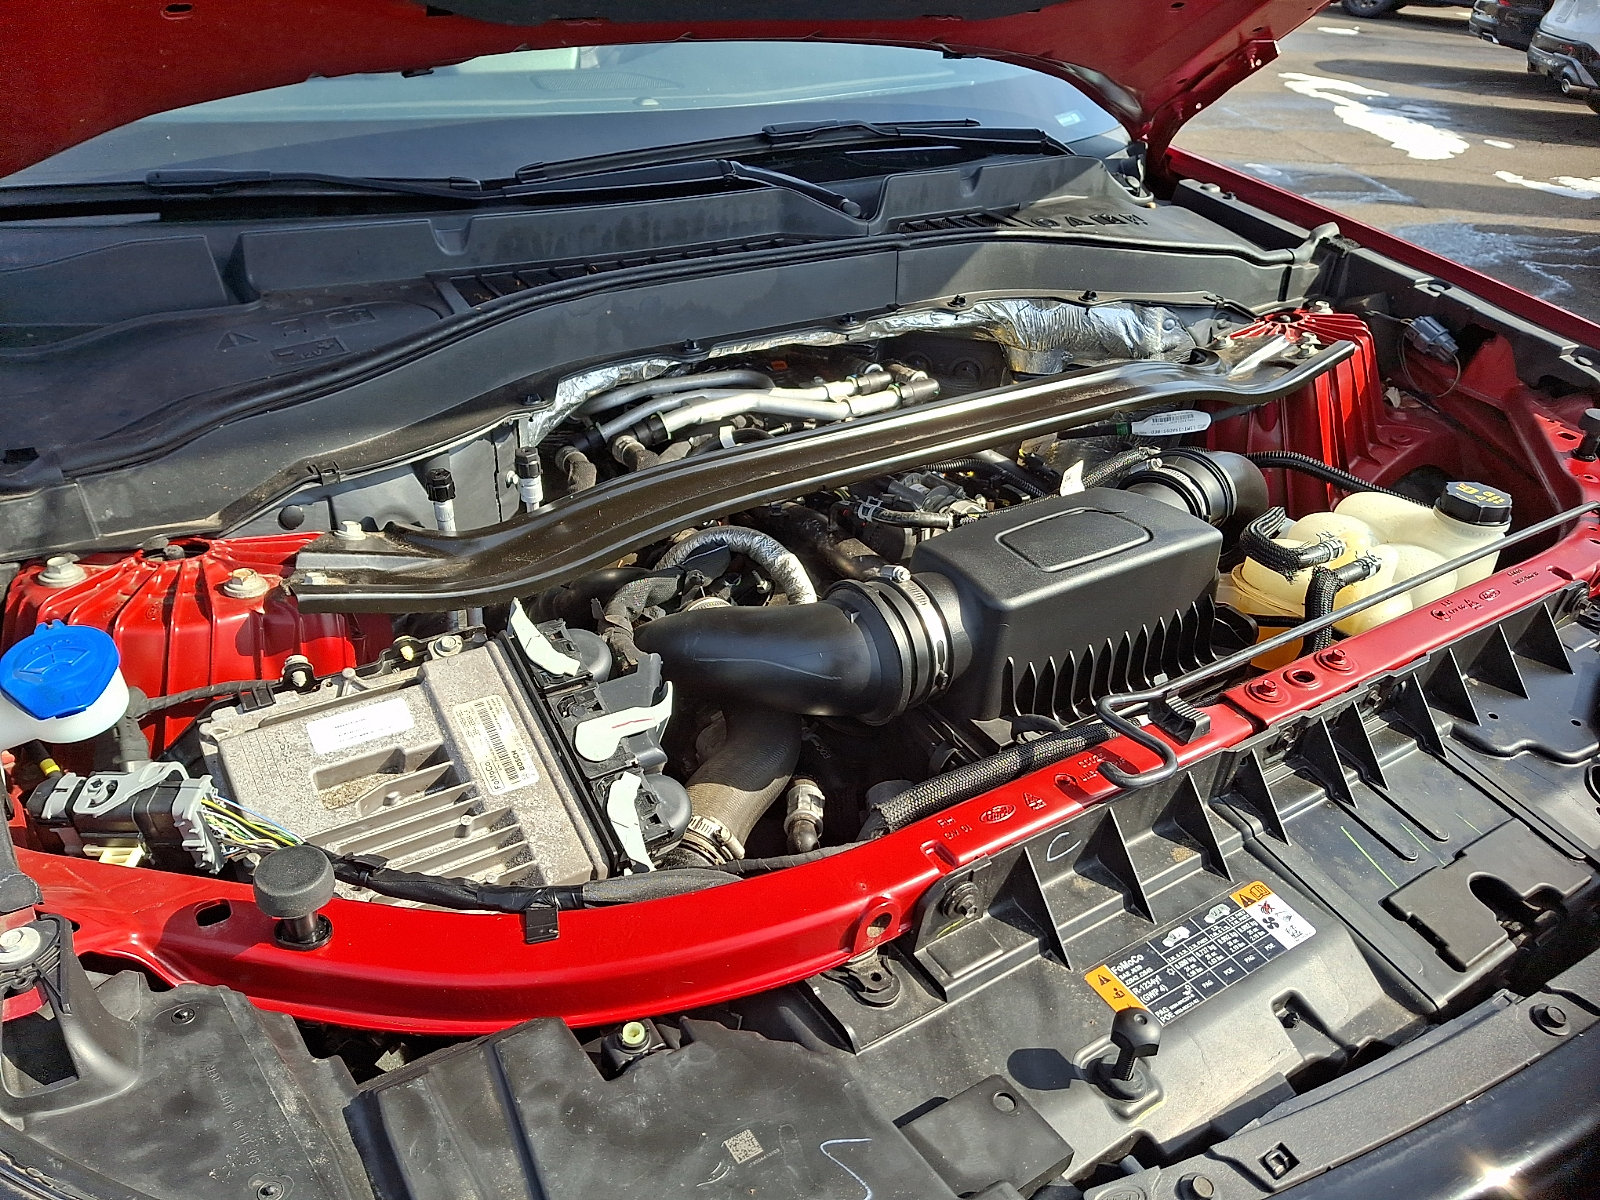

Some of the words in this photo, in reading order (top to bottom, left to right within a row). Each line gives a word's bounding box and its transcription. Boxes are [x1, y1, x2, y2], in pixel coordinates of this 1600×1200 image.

[512, 750, 525, 771] BOSCH
[484, 762, 501, 790] FoMoCo
[1264, 942, 1276, 951] POE
[1111, 954, 1144, 974] FoMoCo
[1244, 955, 1255, 963] PAG
[1223, 967, 1235, 976] POE
[1132, 975, 1162, 995] R-1234yf
[1202, 980, 1214, 988] PAG
[1140, 988, 1159, 1003] (GWP
[1154, 1007, 1170, 1017] PAG
[1160, 1012, 1175, 1023] POE
